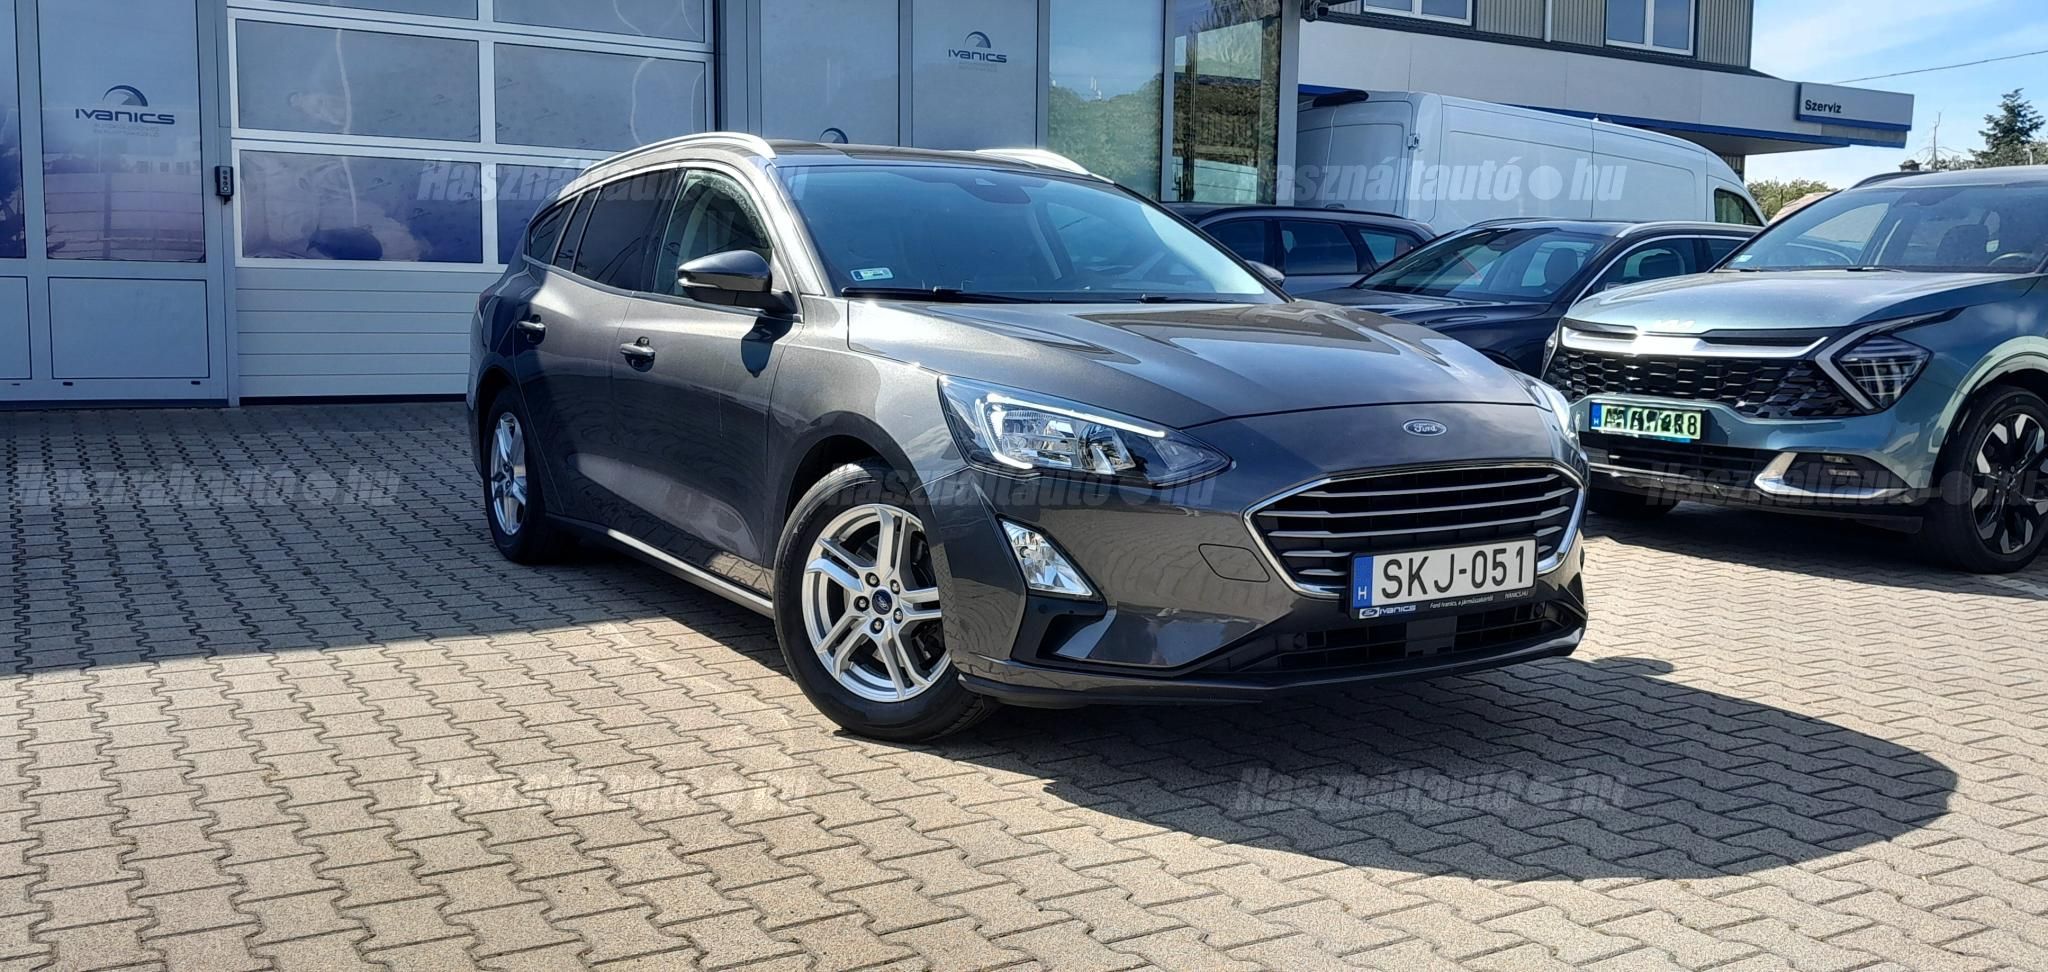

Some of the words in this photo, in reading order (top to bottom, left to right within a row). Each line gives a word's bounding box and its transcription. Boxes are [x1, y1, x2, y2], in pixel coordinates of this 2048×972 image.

[1804, 99, 1842, 114] Szerviz
[1413, 423, 1438, 433] Ford
[1381, 545, 1525, 600] SKJ-051
[1357, 585, 1368, 601] H
